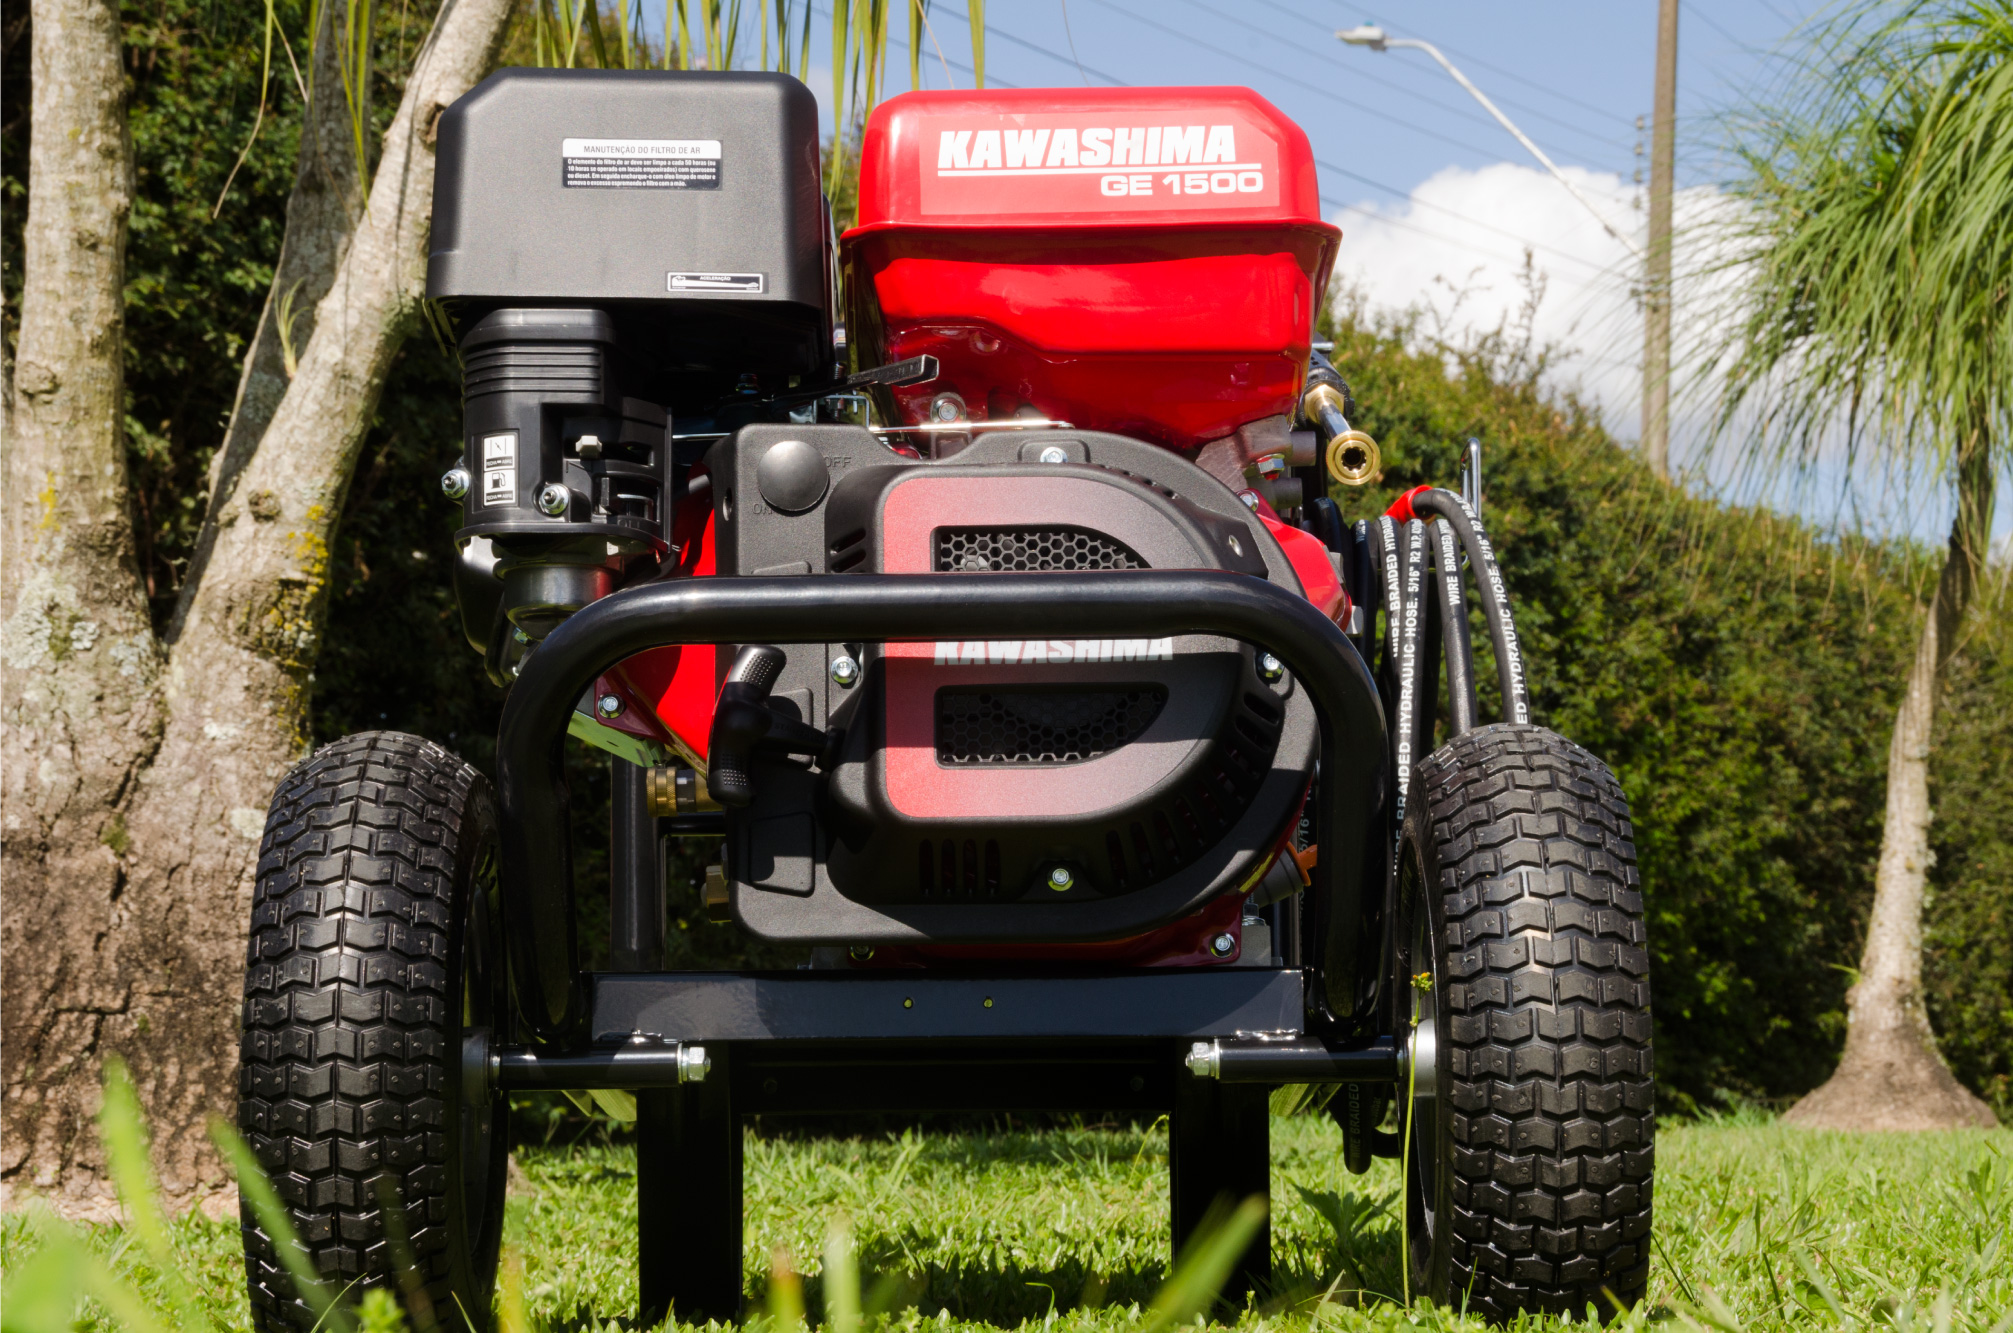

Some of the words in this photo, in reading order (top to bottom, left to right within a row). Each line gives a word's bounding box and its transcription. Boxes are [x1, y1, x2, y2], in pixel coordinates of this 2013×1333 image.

[584, 145, 636, 155] MANUTENÇÃO
[937, 125, 1237, 168] KAWASHIMA
[1100, 174, 1152, 196] GE
[1162, 172, 1264, 195] 1500
[824, 456, 851, 468] OFF
[1470, 520, 1484, 532] R2
[1409, 550, 1421, 562] R2
[1442, 535, 1457, 572] BRAIDED
[1480, 534, 1495, 560] 5/16"
[1386, 554, 1401, 610] BRAIDED
[1408, 566, 1420, 592] 5/16"
[1447, 576, 1461, 605] WIRE
[1488, 565, 1508, 602] HOSE.
[1404, 597, 1419, 637] HOSE.
[934, 636, 1173, 665] KAWASHIMA
[1500, 608, 1525, 694] HYDRAULIC
[1400, 643, 1415, 733] HYDRAULIC
[1348, 1084, 1360, 1135] BRAIDED
